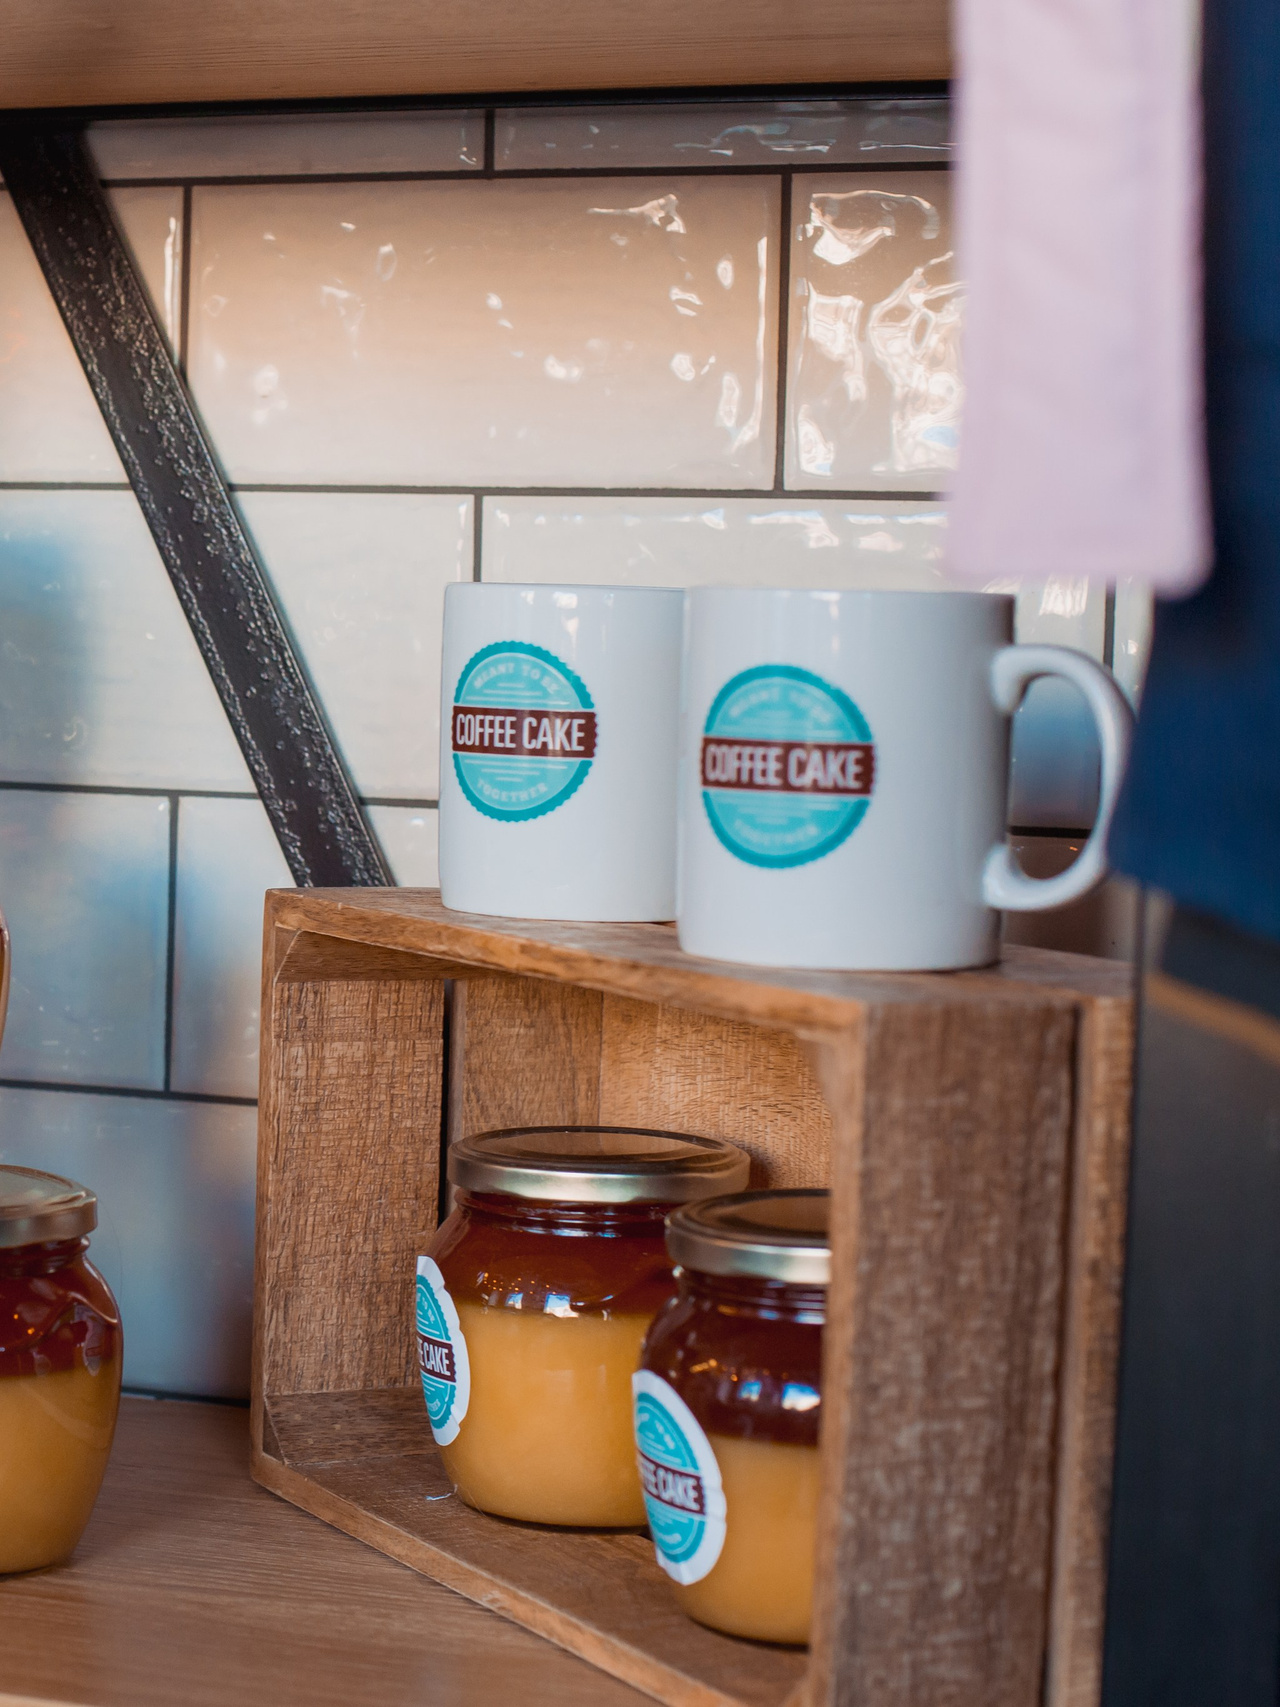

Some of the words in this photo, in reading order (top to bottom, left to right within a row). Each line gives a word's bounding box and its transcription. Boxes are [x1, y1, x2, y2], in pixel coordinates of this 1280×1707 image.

[456, 714, 517, 748] COFFEE
[522, 717, 586, 751] CAKE
[705, 743, 783, 786] COFFEE
[787, 748, 865, 790] CAKE
[423, 1342, 451, 1376] CAKE
